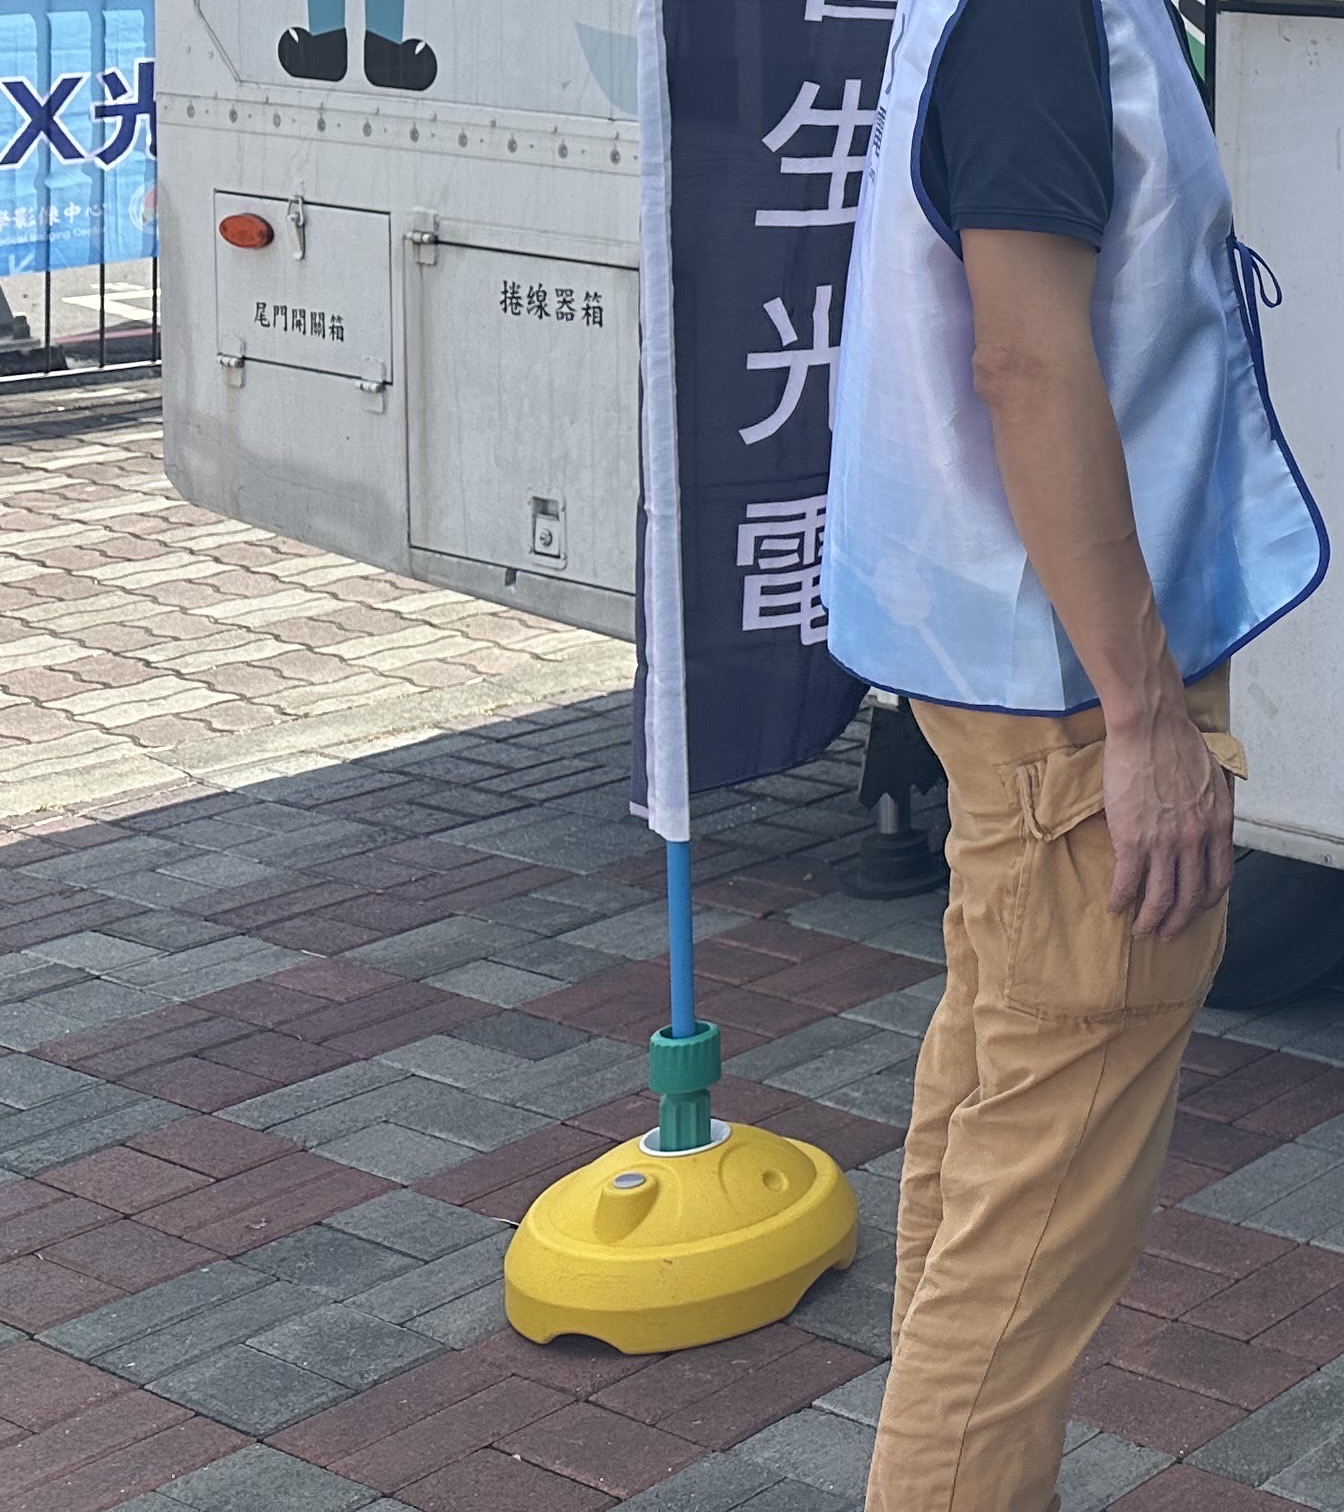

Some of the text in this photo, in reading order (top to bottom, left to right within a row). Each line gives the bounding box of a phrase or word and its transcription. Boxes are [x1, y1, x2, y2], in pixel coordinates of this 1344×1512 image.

[0, 59, 157, 169] X光
[254, 301, 345, 343] 尾門開關箱
[499, 279, 604, 328] 捲線器箱
